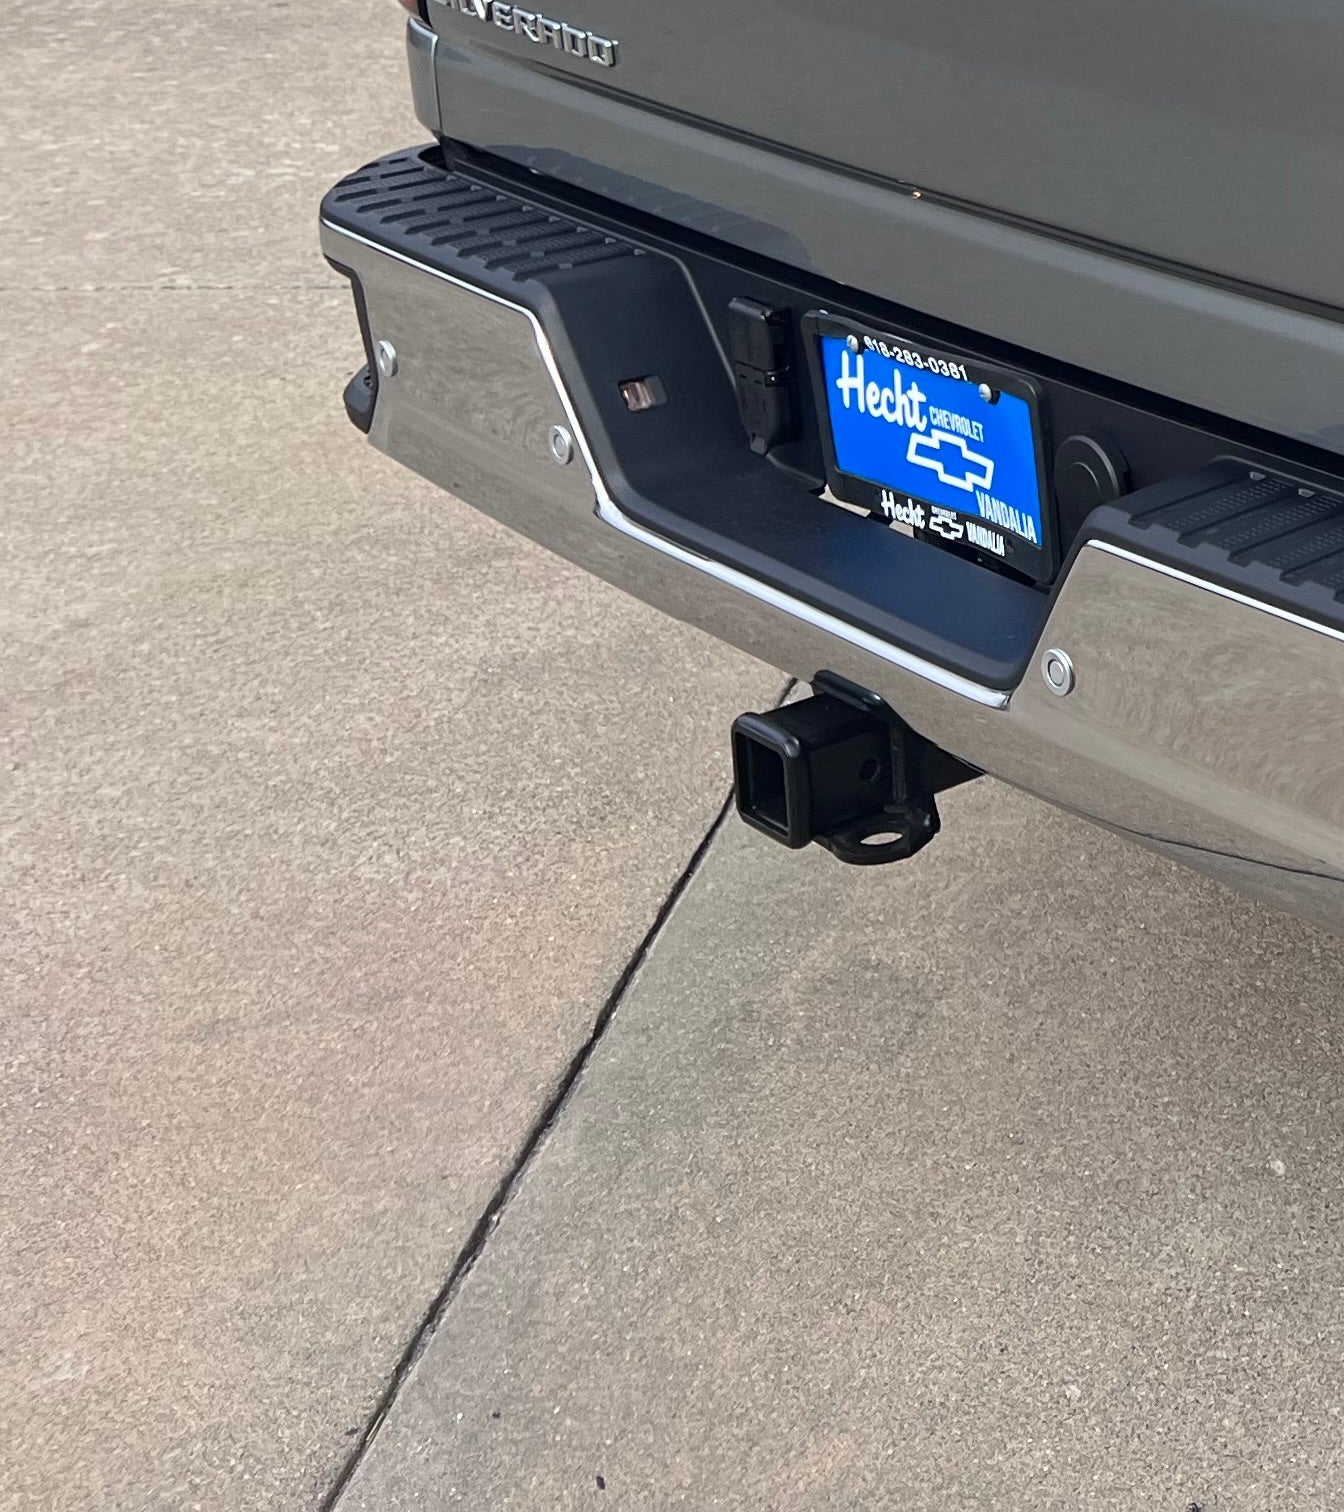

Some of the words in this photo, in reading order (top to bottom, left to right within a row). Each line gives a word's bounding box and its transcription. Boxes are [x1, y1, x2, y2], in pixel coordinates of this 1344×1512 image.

[836, 350, 928, 432] Hecht
[929, 406, 984, 442] CHEVROLET
[881, 489, 926, 529] Hecht
[966, 521, 1006, 557] VANDALIA
[975, 490, 1037, 544] VANDALIA
